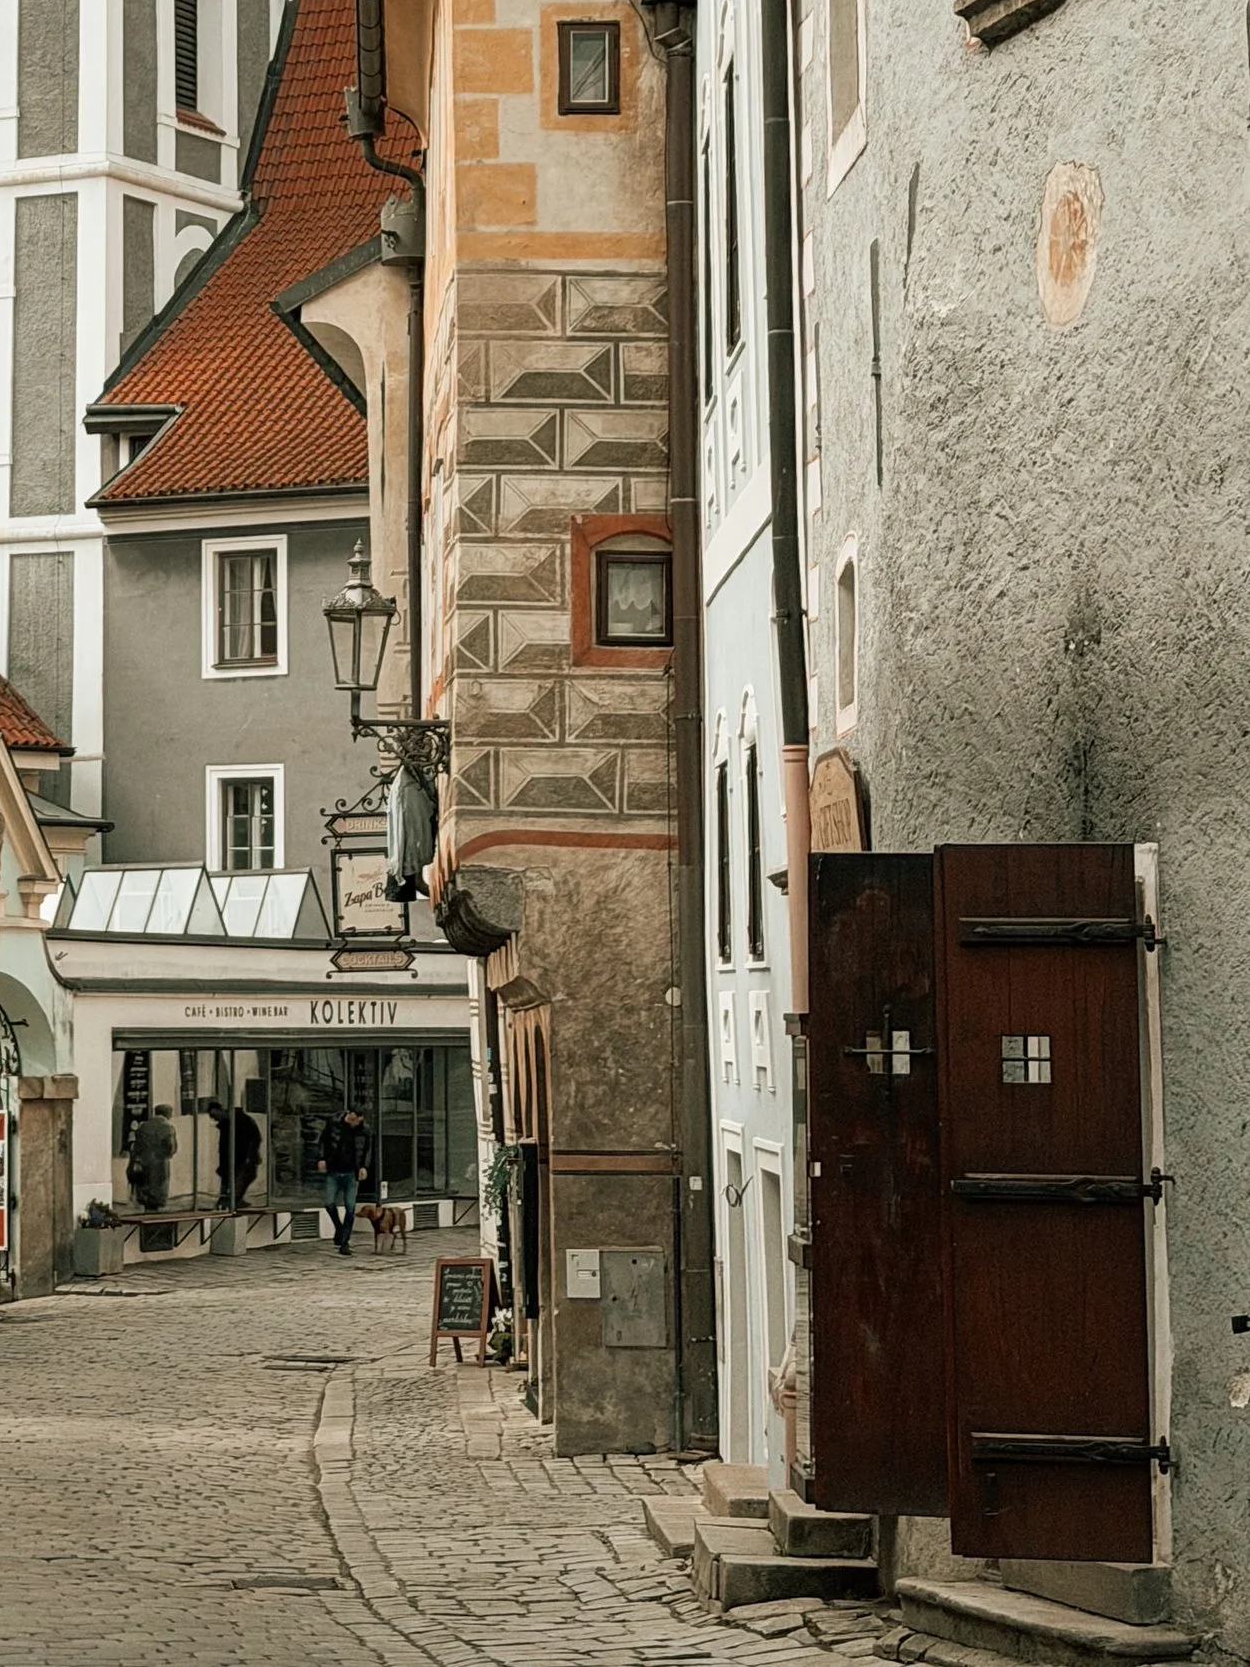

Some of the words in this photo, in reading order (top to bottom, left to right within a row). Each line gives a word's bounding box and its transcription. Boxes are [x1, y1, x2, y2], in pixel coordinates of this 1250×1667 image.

[344, 890, 372, 907] Zapa
[340, 953, 402, 967] COCKTAILS
[185, 1003, 206, 1018] CAFÉ
[216, 1006, 244, 1018] BISTRO
[310, 1000, 398, 1024] KOLEKTIV
